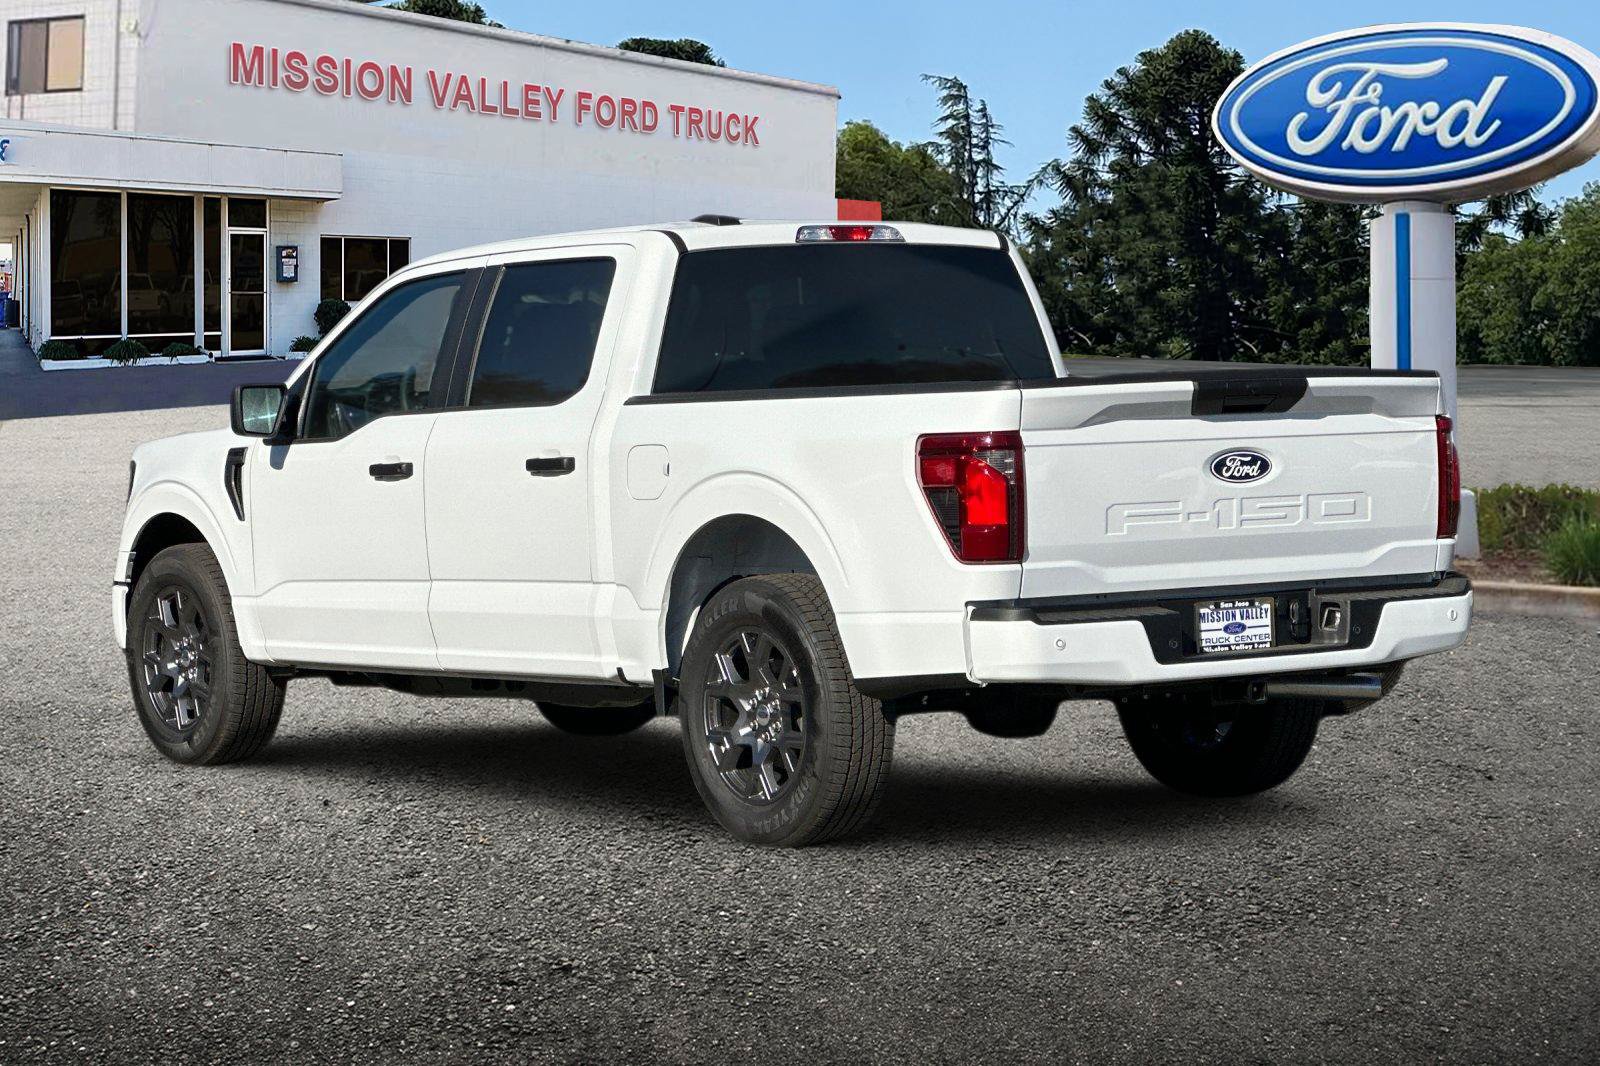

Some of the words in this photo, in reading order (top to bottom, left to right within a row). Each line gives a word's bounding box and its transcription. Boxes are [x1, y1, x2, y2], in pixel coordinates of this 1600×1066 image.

[229, 42, 413, 104] MISSION
[428, 69, 565, 122] VALLEY
[576, 89, 659, 134] FORD
[670, 103, 761, 146] TRUCK
[1286, 57, 1509, 156] Ford
[1222, 455, 1261, 478] Ford
[1106, 491, 1371, 535] F-150
[1200, 609, 1237, 623] MISSION
[1240, 607, 1269, 620] VALLEY
[1227, 624, 1243, 633] Ford
[1201, 636, 1230, 645] TRUCK
[1234, 633, 1270, 643] CENTER
[1230, 643, 1253, 651] Valley
